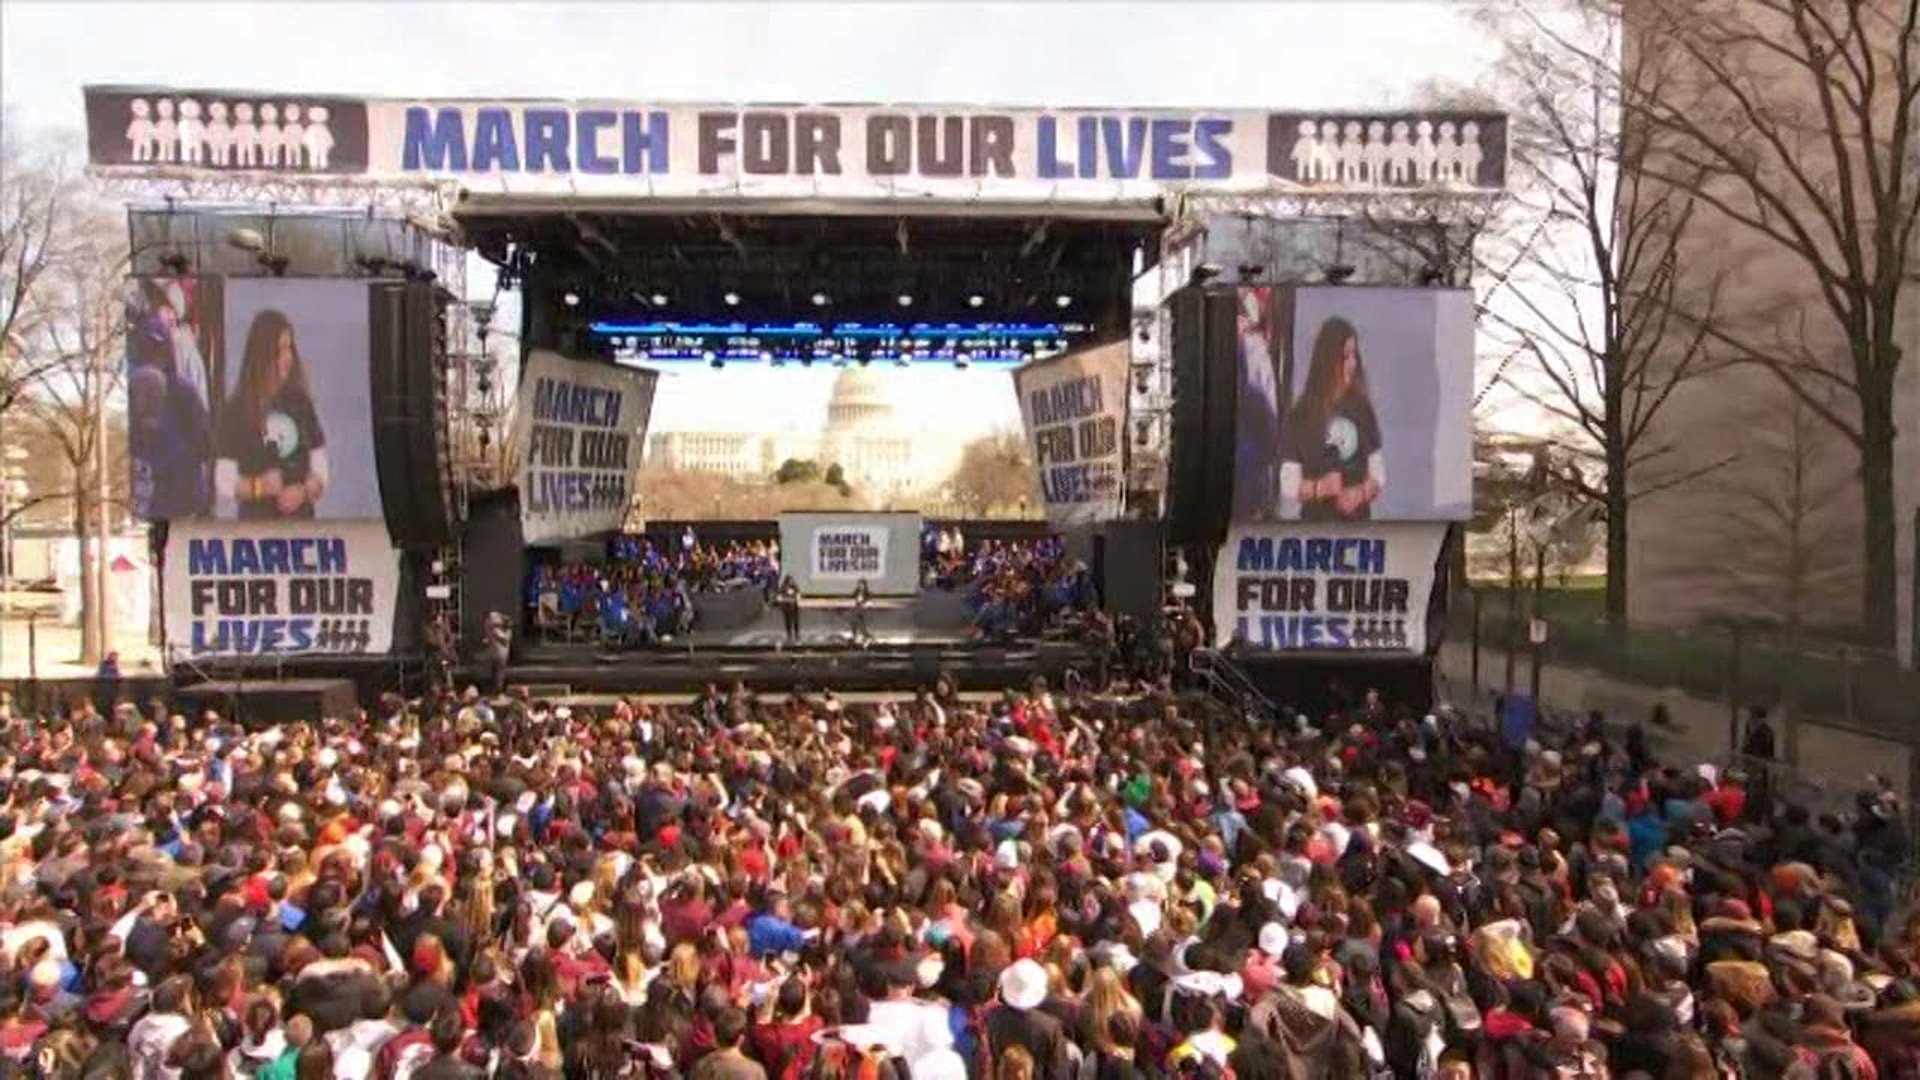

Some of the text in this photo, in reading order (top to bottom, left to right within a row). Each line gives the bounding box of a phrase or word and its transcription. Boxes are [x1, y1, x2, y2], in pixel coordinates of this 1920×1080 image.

[403, 106, 1234, 180] MARCH FOR OUR LIVES
[533, 377, 623, 428] MARCH
[1031, 373, 1105, 426] MARCH
[529, 424, 631, 469] FOR OUR
[1036, 415, 1118, 466] FOR OUR
[527, 470, 593, 513] LIVES
[189, 538, 347, 575] MARCH
[818, 533, 870, 545] MARCH
[818, 546, 879, 559] FOR OUR
[1237, 536, 1386, 574] MARCH
[818, 560, 860, 572] LIVES
[191, 578, 374, 616] FOR OUR
[1237, 577, 1409, 613] FOR OUR
[191, 619, 314, 654] LIVES
[1237, 616, 1348, 649] LIVES
